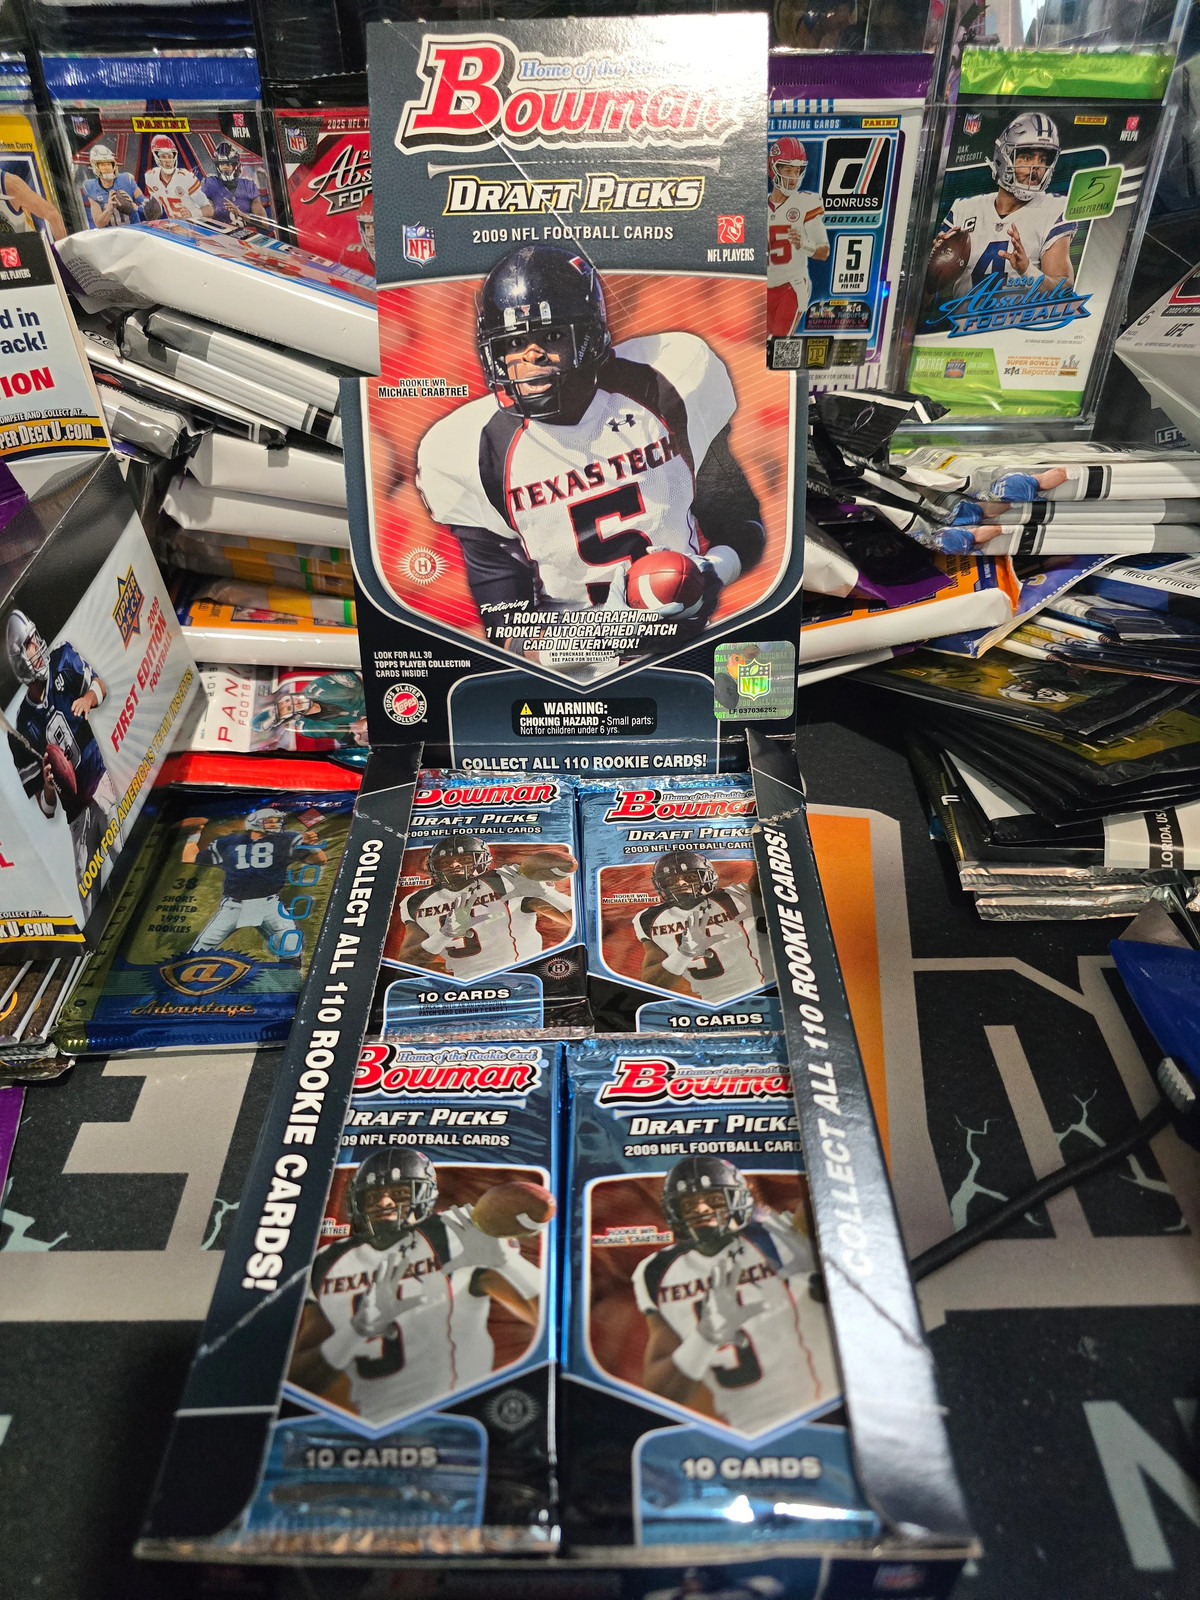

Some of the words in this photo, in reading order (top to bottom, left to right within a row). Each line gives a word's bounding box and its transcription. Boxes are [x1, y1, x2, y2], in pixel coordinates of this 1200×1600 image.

[520, 60, 571, 79] Home
[575, 60, 593, 84] of
[403, 42, 738, 146] Bowman
[135, 118, 187, 130] PANINI
[327, 119, 346, 130] 2025
[347, 118, 361, 129] NFL
[778, 119, 811, 129] TRADING
[814, 119, 840, 129] CARDS
[863, 119, 897, 127] PANINI
[966, 119, 981, 132] NFL
[1075, 116, 1106, 124] PANINI
[231, 126, 251, 138] NFLPA
[1119, 130, 1139, 142] NFLPA
[289, 136, 308, 152] NFL
[957, 145, 969, 155] DAK
[955, 152, 983, 163] PRESCOTT
[444, 177, 581, 215] DRAFT
[581, 174, 705, 212] PICKS
[1077, 175, 1114, 202] 5
[825, 197, 879, 208] DONRUSS
[1069, 204, 1086, 215] CARDS
[1086, 204, 1095, 213] PER
[1095, 202, 1111, 212] PACK
[823, 215, 878, 223] FOOTBALL
[472, 229, 509, 244] 2009
[511, 227, 540, 242] NFL
[543, 225, 620, 241] FOOTBALL
[623, 225, 674, 240] CARDS
[407, 240, 436, 261] NFL
[706, 248, 722, 262] NFL
[722, 247, 755, 262] PLAYERS
[845, 239, 863, 271] 5
[838, 273, 865, 283] CARDS
[1006, 276, 1035, 287] 2020
[926, 271, 1079, 324] Absolute
[963, 301, 1078, 332] FOOTBALL
[1164, 323, 1195, 338] UFC
[1021, 367, 1058, 377] Reporter
[399, 379, 430, 387] ROOKIE
[431, 378, 446, 387] WR
[378, 387, 419, 398] MICHAEL
[421, 385, 468, 398] CRABTREE
[507, 462, 606, 512] TEXAS
[607, 435, 682, 480] TECH
[114, 576, 137, 626] UPPER
[480, 599, 530, 616] Featuring
[147, 596, 160, 626] 2009
[503, 614, 510, 624] 1
[512, 612, 559, 624] ROOKIE
[561, 610, 639, 624] AUTOGRAPH
[638, 612, 659, 623] AND
[485, 627, 493, 638] 1
[495, 626, 542, 638] ROOKIE
[543, 625, 635, 638] AUTOGRAPHED
[637, 623, 678, 637] PATCH
[523, 639, 554, 651] CARD
[555, 638, 571, 650] IN
[571, 638, 611, 650] EVERY
[611, 637, 640, 650] BOX!
[149, 631, 173, 694] FOOTBALL
[374, 651, 393, 660] LOOK
[394, 651, 408, 660] FOR
[409, 651, 422, 659] ALL
[423, 651, 432, 659] 30
[375, 660, 399, 668] TOPPS
[399, 660, 427, 668] PLAYER
[428, 659, 471, 668] COLLECTION
[375, 670, 401, 678] CARDS
[401, 669, 429, 678] INSIDE!
[110, 683, 139, 753] FIRST
[136, 610, 168, 692] EDITION
[740, 677, 768, 695] NFL
[394, 685, 421, 699] PLAYER
[385, 690, 396, 713] TOPPS
[543, 701, 609, 715] WARNING:
[391, 700, 426, 724] COLLECTION
[520, 726, 533, 735] Not
[534, 726, 546, 735] for
[546, 726, 576, 735] children
[577, 726, 599, 735] under
[599, 726, 605, 735] 6
[461, 757, 529, 771] COLLECT
[532, 757, 560, 770] ALL
[564, 756, 590, 769] 110
[593, 755, 649, 769] ROOKIE
[652, 754, 708, 768] CARDS!
[78, 848, 105, 899] LOOK
[100, 816, 120, 856] FOR
[117, 745, 156, 827] AMERICA'S
[152, 710, 172, 752] TEAM
[410, 815, 477, 828] DRAFT
[480, 813, 539, 825] PICKS
[431, 829, 451, 837] NFL
[452, 827, 505, 836] FOOTBALL
[506, 826, 542, 835] CARDS
[672, 842, 725, 850] FOOTBALL
[234, 842, 275, 870] 18
[762, 826, 800, 904] CARDS!
[343, 839, 384, 927] COLLECT
[161, 895, 198, 903] SHORT-
[268, 839, 328, 956] 1999
[155, 904, 198, 914] PRINTED
[160, 914, 187, 923] 1999
[147, 925, 191, 934] ROOKIES
[329, 932, 361, 976] ALL
[776, 904, 821, 1002] ROOKIE
[317, 981, 349, 1024] 110
[418, 991, 440, 1003] 10
[442, 989, 511, 1001] CARDS
[130, 1001, 256, 1019] Advantage
[669, 1016, 691, 1028] 10
[695, 1013, 763, 1026] CARDS
[799, 1003, 830, 1051] 110
[397, 1051, 433, 1063] Home
[434, 1052, 447, 1064] of
[448, 1051, 465, 1061] the
[466, 1051, 507, 1062] Rookie
[508, 1049, 538, 1060] Card
[353, 1044, 540, 1097] Bowman
[282, 1029, 341, 1146] ROOKIE
[807, 1060, 841, 1116] ALL
[628, 1117, 719, 1137] DRAFT
[817, 1117, 874, 1277] COLLECT
[241, 1153, 309, 1292] CARDS!
[305, 1449, 336, 1470] 10
[340, 1447, 439, 1468] CARDS
[682, 1457, 717, 1480] 10
[719, 1456, 823, 1479] CARDS
